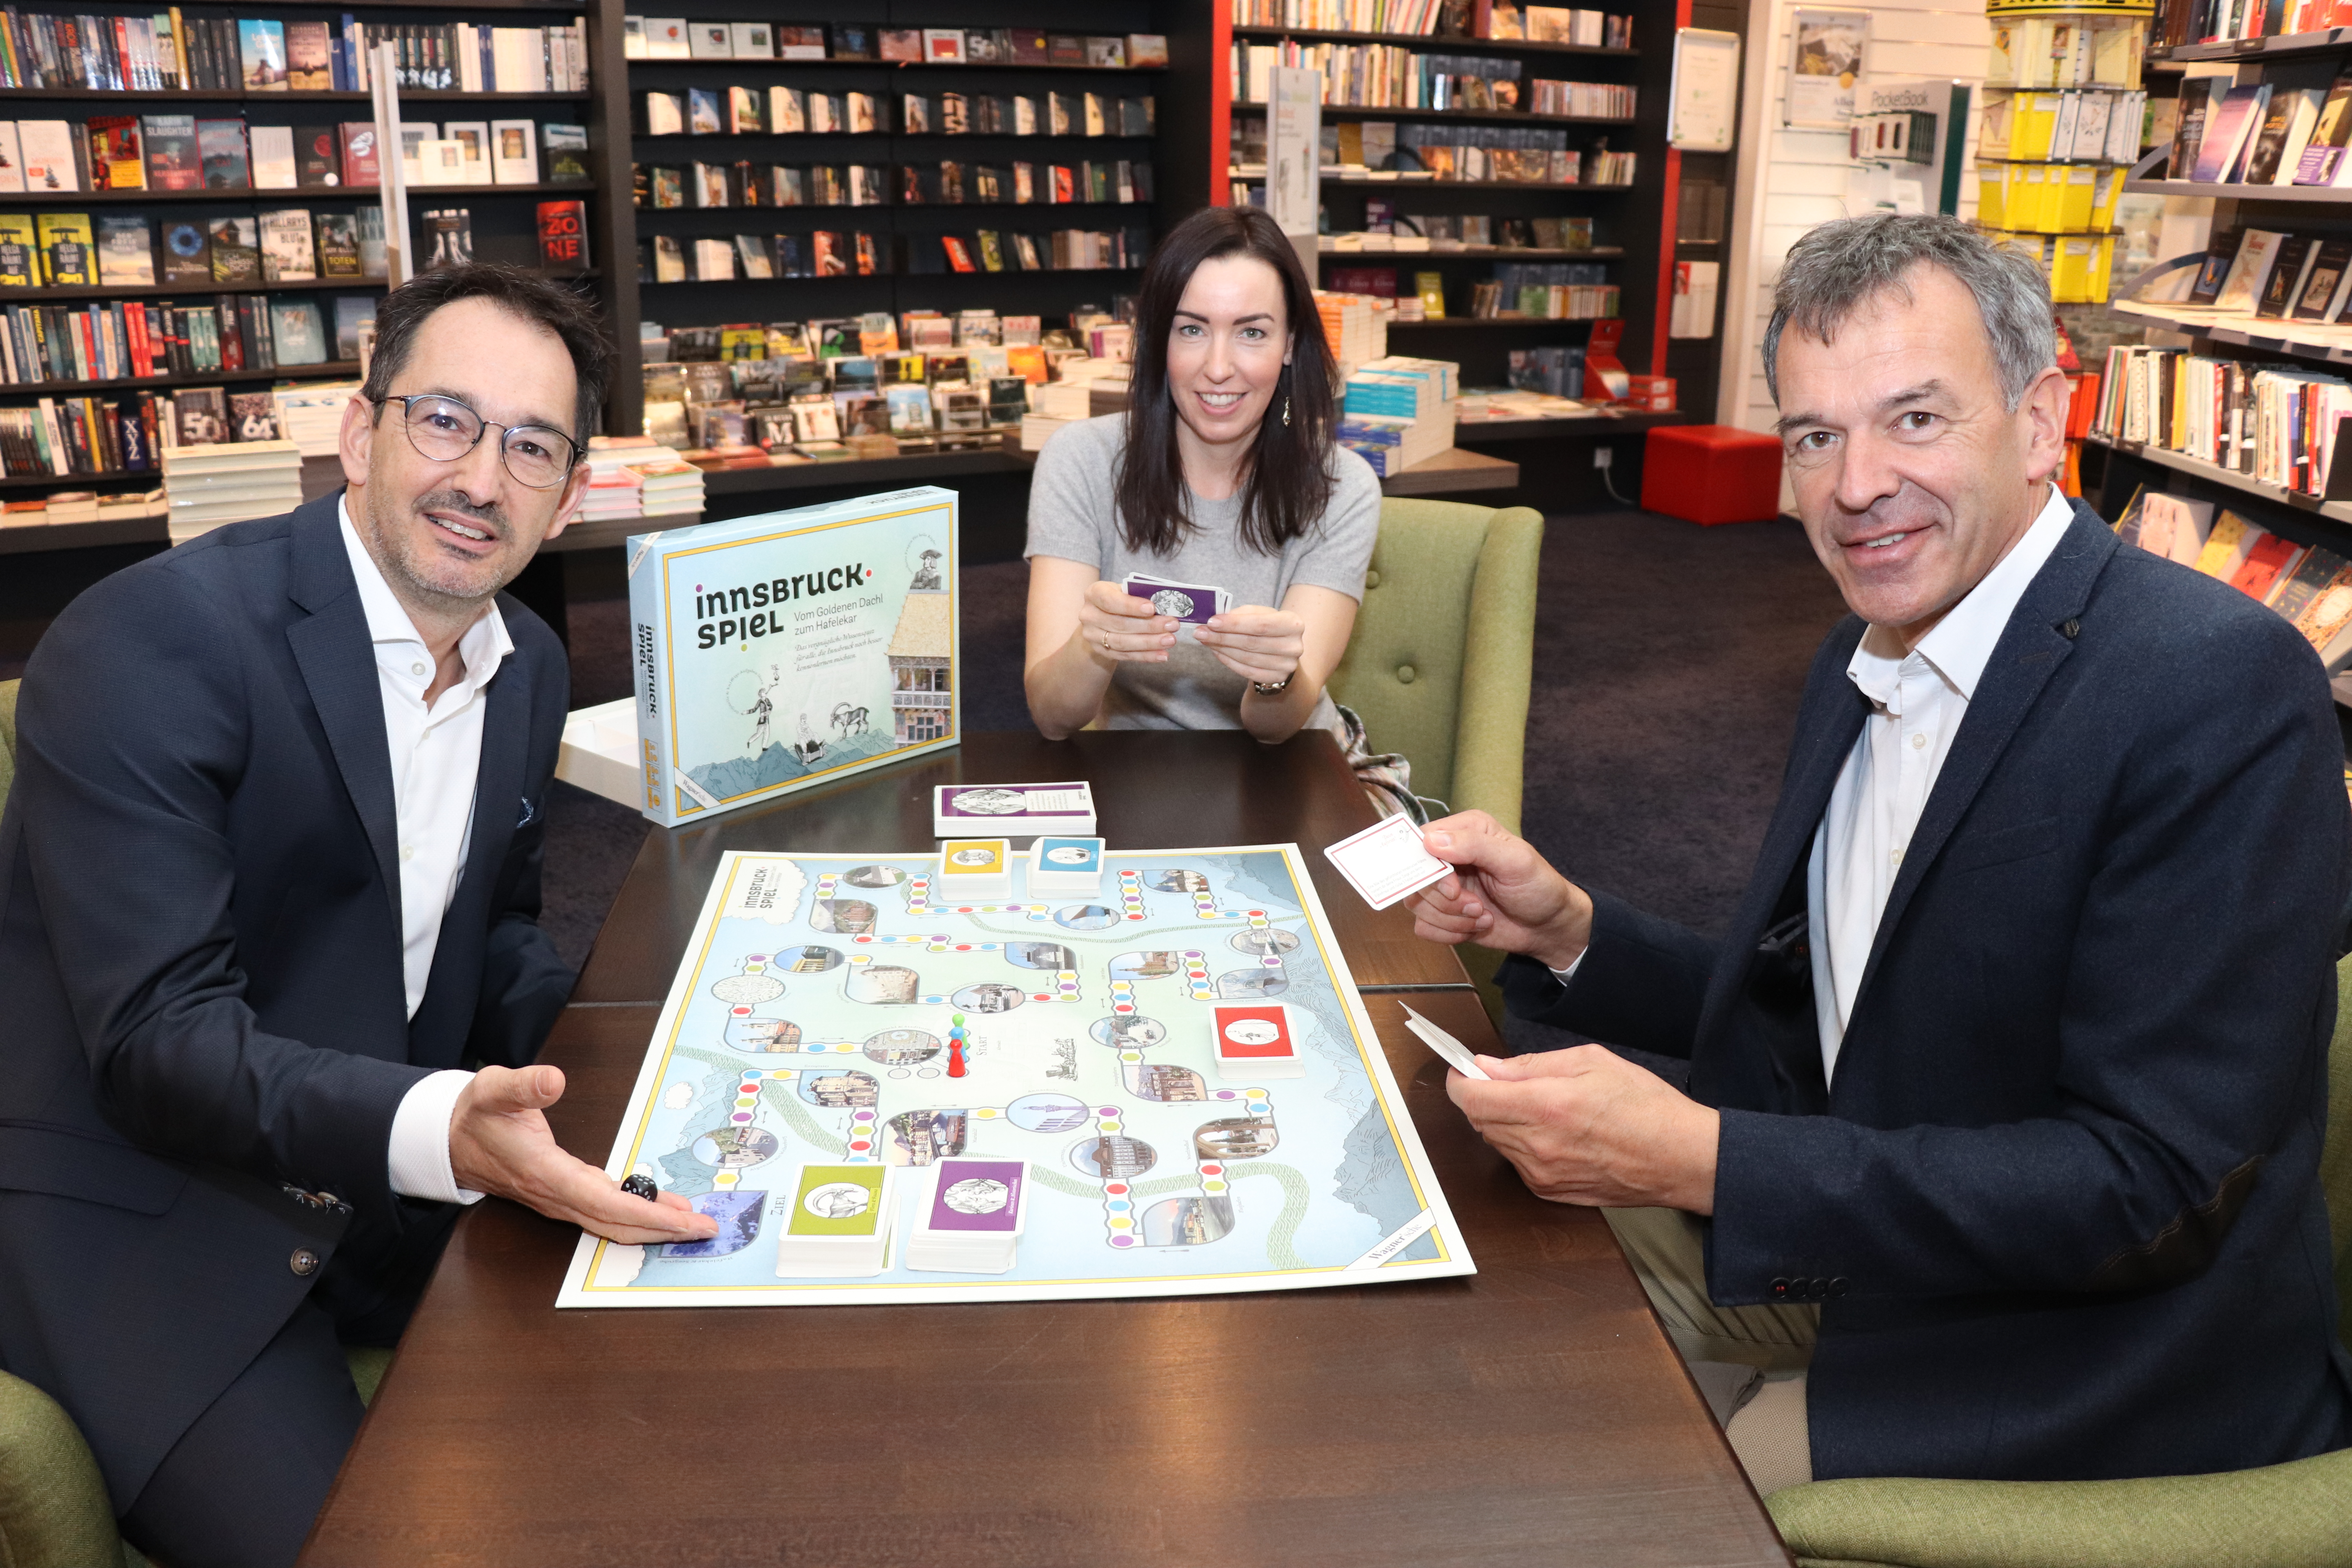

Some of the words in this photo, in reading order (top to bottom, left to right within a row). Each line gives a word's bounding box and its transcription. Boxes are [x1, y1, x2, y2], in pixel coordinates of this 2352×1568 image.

[1872, 89, 1929, 107] PocketBook
[146, 127, 193, 136] SLAUGHTER
[794, 611, 815, 621] Vom
[817, 601, 857, 617] Goldenen
[859, 593, 884, 607] Dachl
[795, 626, 814, 635] zum
[816, 614, 857, 630] Hafelekar
[808, 636, 842, 650] vergnügliche
[842, 629, 875, 641] Wissensquiz
[827, 642, 854, 654] Innsbruck
[855, 639, 867, 648] noch
[796, 659, 833, 671] kennenlernen
[833, 653, 857, 663] möchten.
[976, 1036, 987, 1056] START
[770, 1194, 786, 1216] ZIEL
[1368, 1223, 1422, 1261] Wagner'sche
